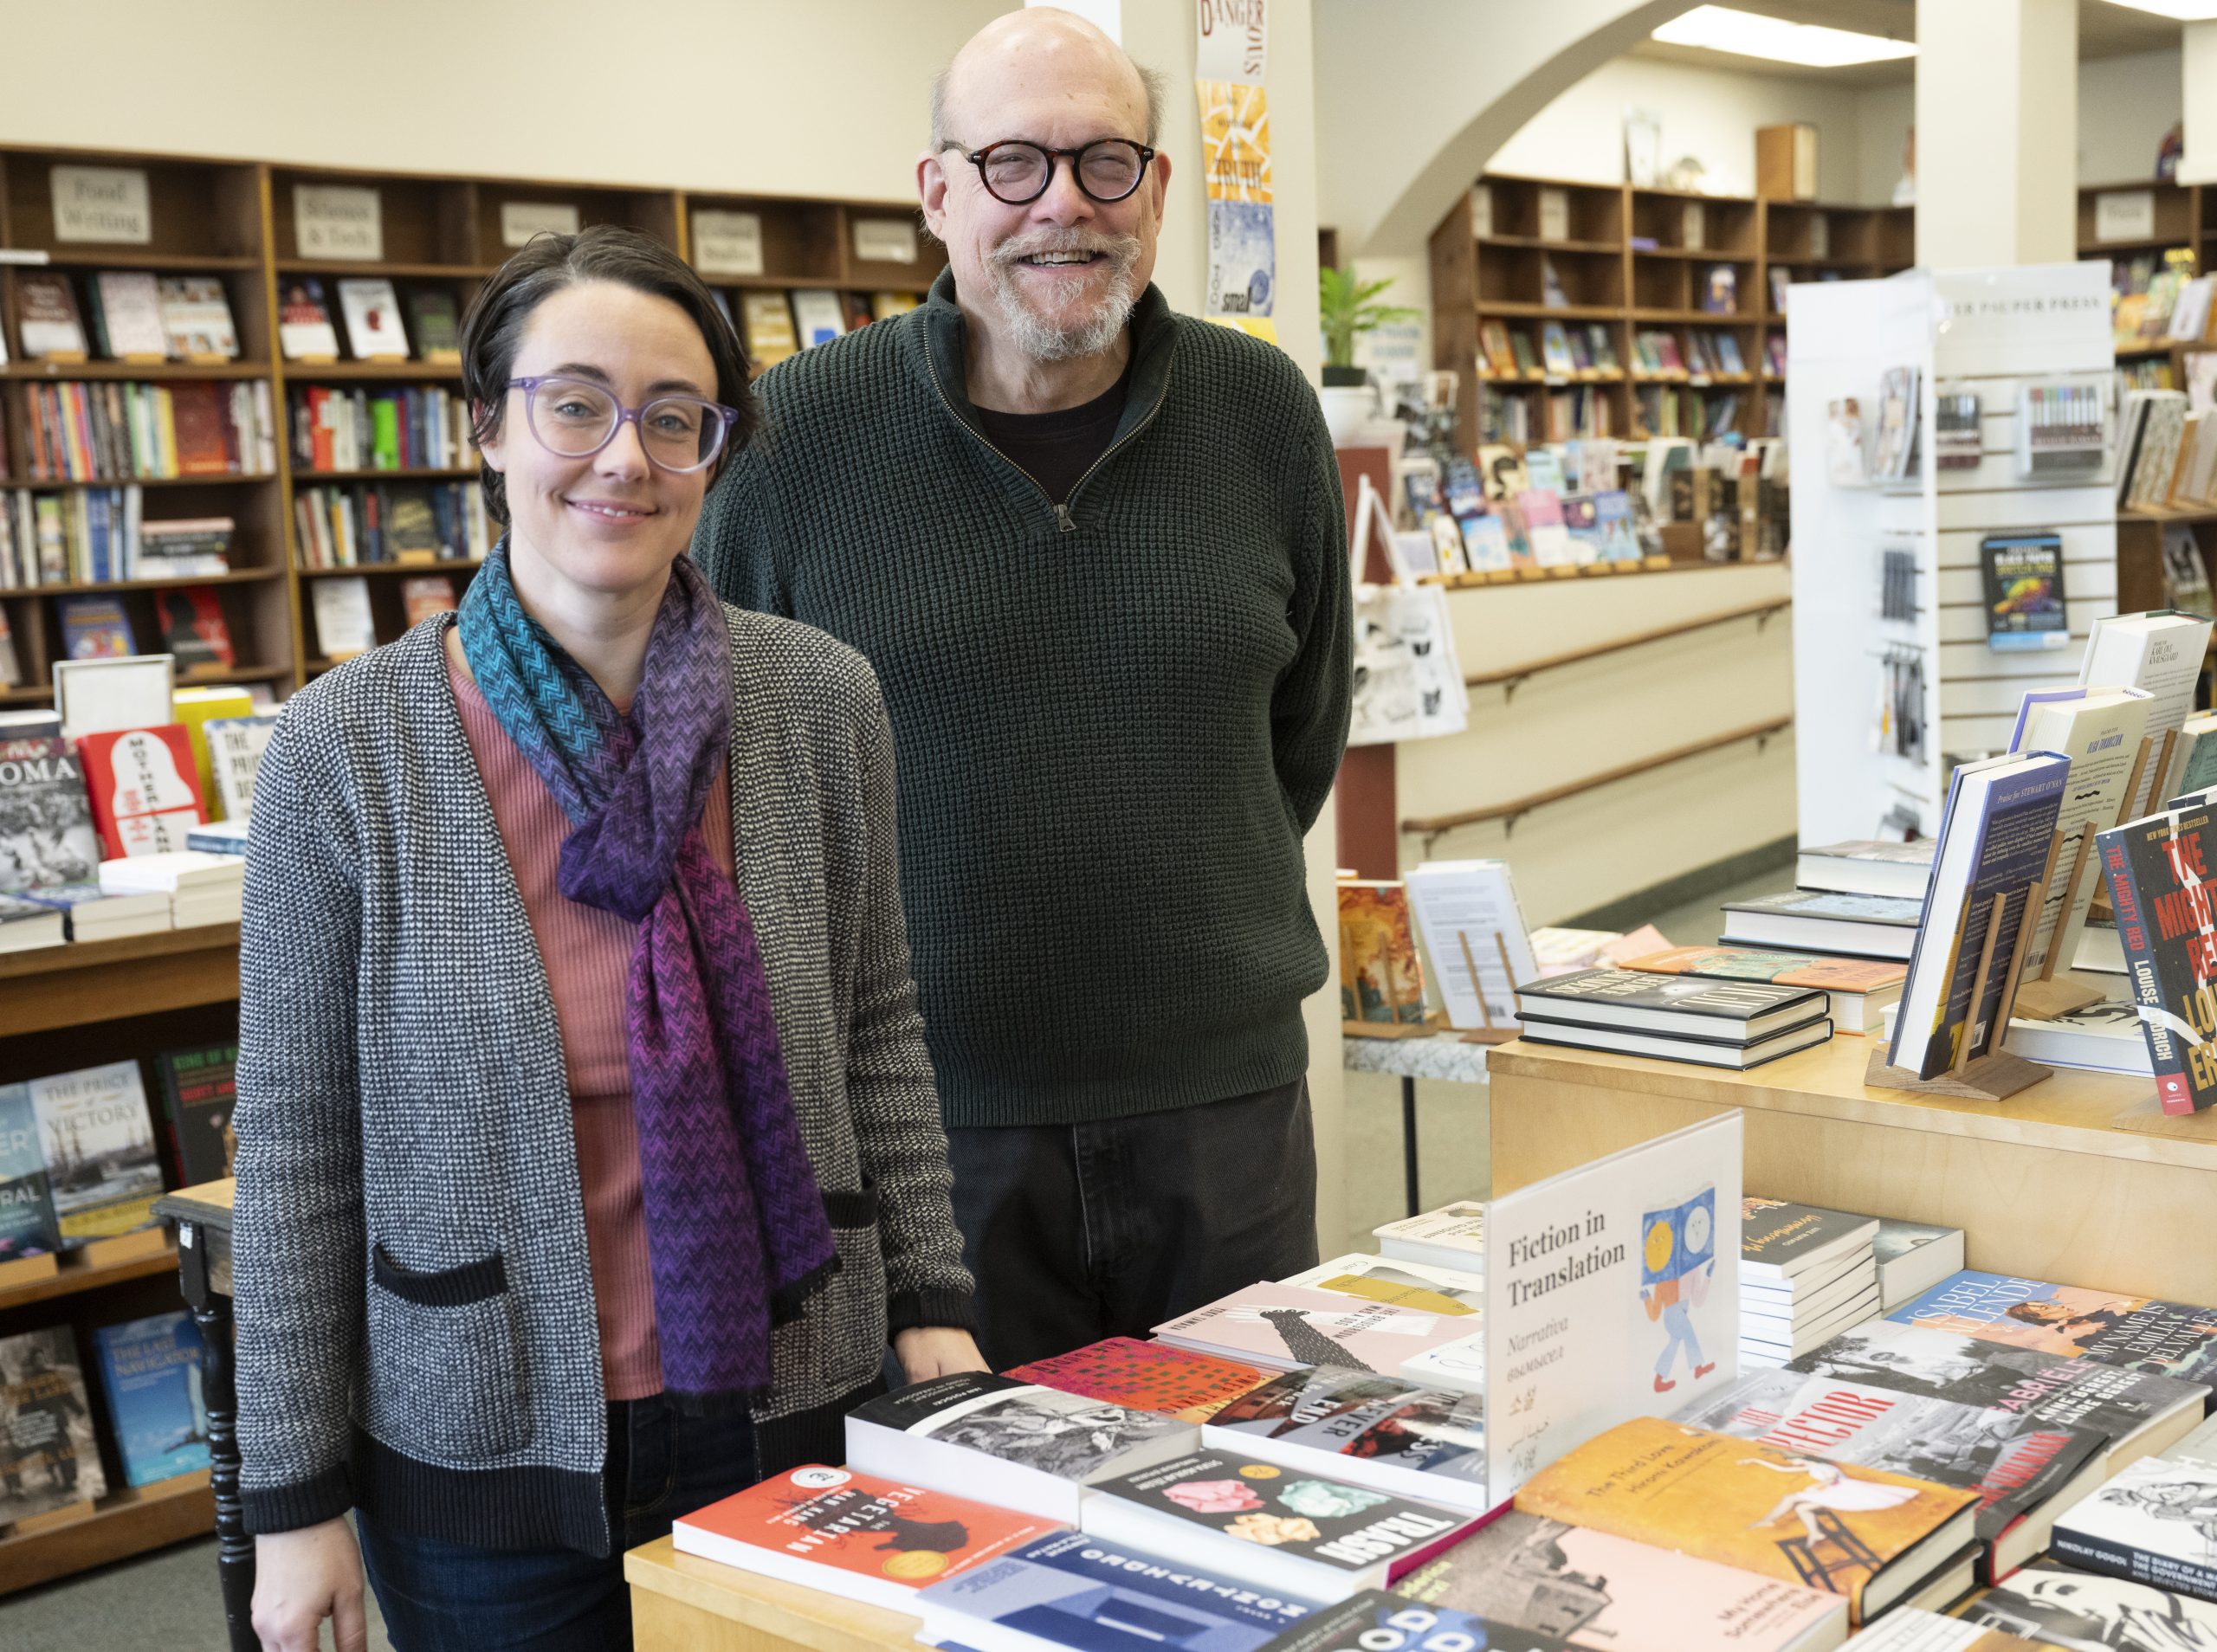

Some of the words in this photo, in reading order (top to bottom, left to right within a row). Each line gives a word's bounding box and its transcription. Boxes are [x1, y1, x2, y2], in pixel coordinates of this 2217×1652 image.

[2106, 845, 2121, 870] THE
[2162, 833, 2207, 885] THE
[2113, 874, 2138, 923] MIGHTY
[2127, 926, 2145, 951] RED
[2134, 959, 2152, 1005] LOUISE
[2149, 1007, 2174, 1062] ERDRICH
[1508, 1225, 1580, 1269] Fiction
[1586, 1210, 1605, 1236] in
[1507, 1243, 1626, 1308] Translation
[1201, 1307, 1228, 1321] YOKO
[1906, 1280, 2001, 1325] ISABEL
[1507, 1317, 1568, 1357] Narrativa
[2084, 1337, 2119, 1358] MY
[2109, 1313, 2156, 1343] NAME
[2139, 1304, 2167, 1315] IS
[2124, 1320, 2183, 1353] EMILIA
[2142, 1347, 2185, 1365] DEL
[1157, 1396, 1208, 1415] TOKYO
[1290, 1397, 1341, 1424] END
[1322, 1398, 1397, 1438] NEVER
[2035, 1396, 2077, 1422] ANNE
[2070, 1371, 2120, 1400] BEREST
[2056, 1401, 2103, 1425] LAIRE
[2096, 1372, 2149, 1400] BEREST
[1755, 1391, 1897, 1453] RECTOR
[1586, 1480, 1616, 1496] The
[1608, 1458, 1647, 1481] Third
[1641, 1443, 1675, 1462] Love
[783, 1502, 824, 1527] KANG
[785, 1487, 927, 1553] VEGETARIAN
[824, 1489, 856, 1508] HAN
[1314, 1511, 1461, 1565] TRASH
[2133, 1551, 2150, 1563] THE
[2132, 1560, 2150, 1571] THE
